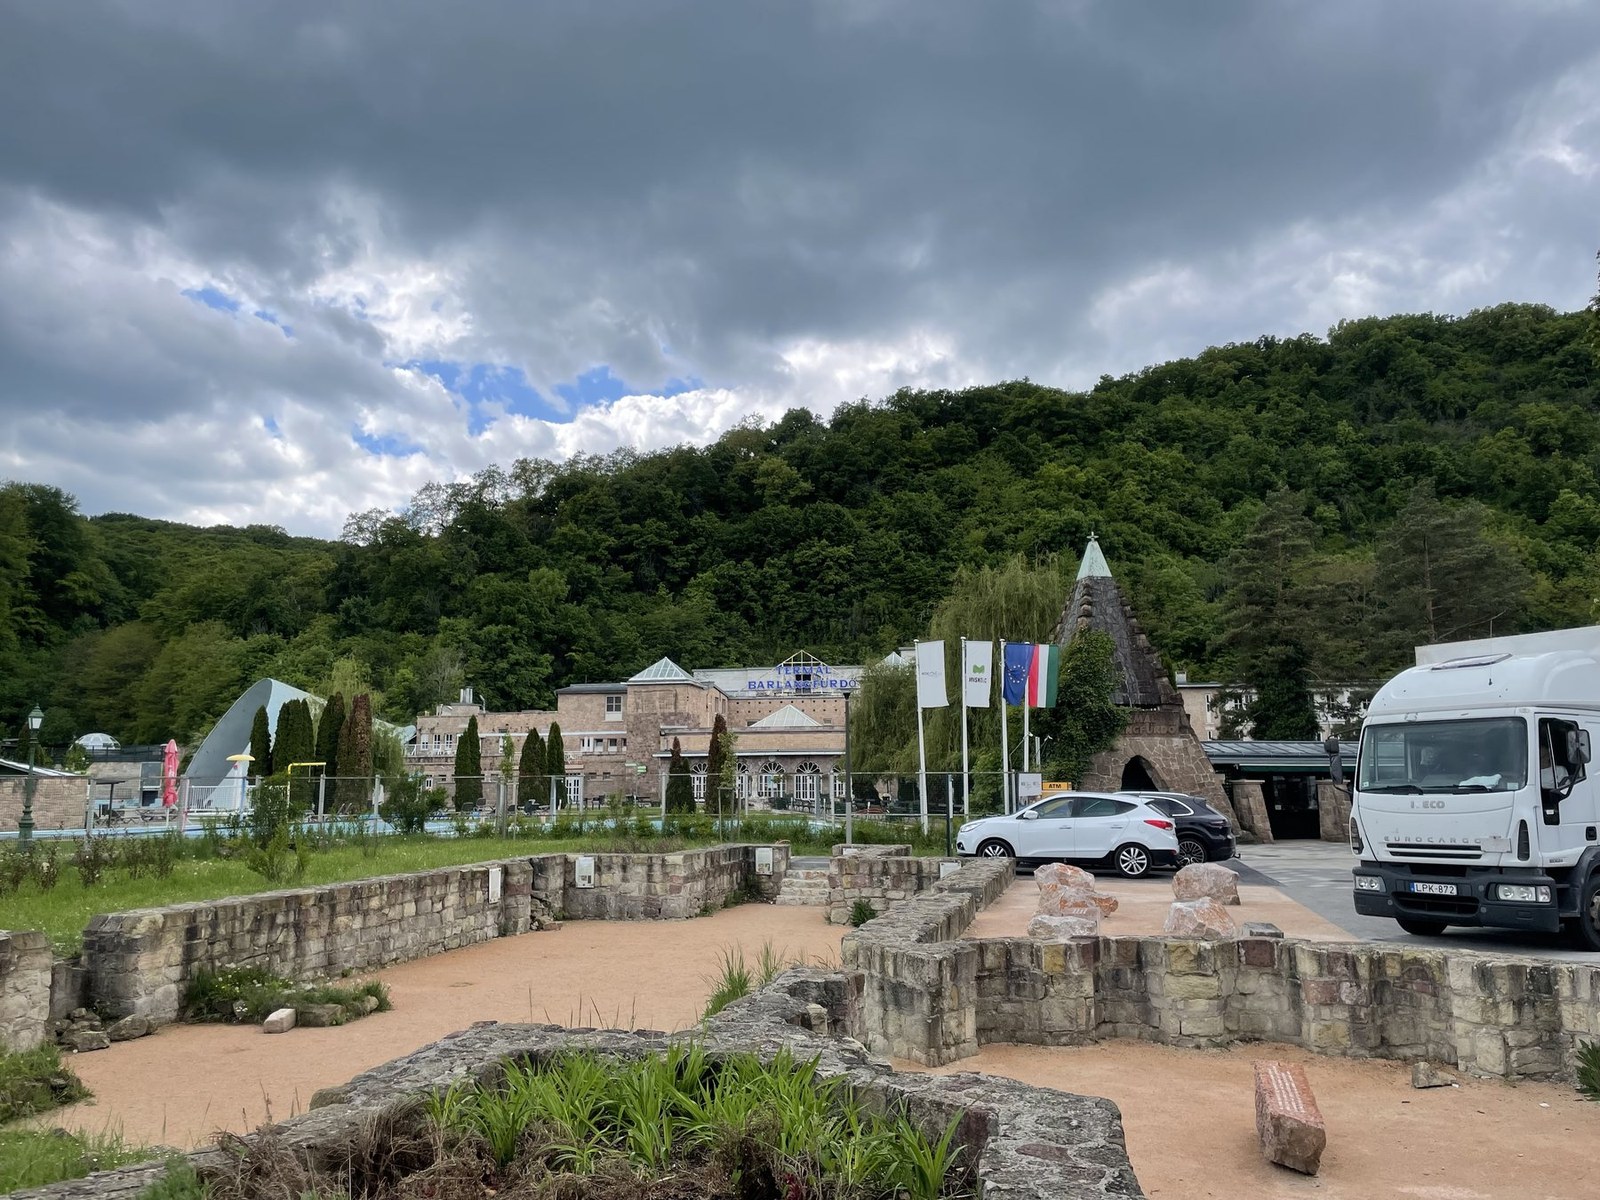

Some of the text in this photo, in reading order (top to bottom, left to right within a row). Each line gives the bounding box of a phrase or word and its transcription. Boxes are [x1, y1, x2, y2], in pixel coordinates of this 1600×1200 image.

[1410, 800, 1446, 809] IECO
[1384, 835, 1482, 844] EUROCARGO
[1415, 883, 1455, 895] LPK-872
